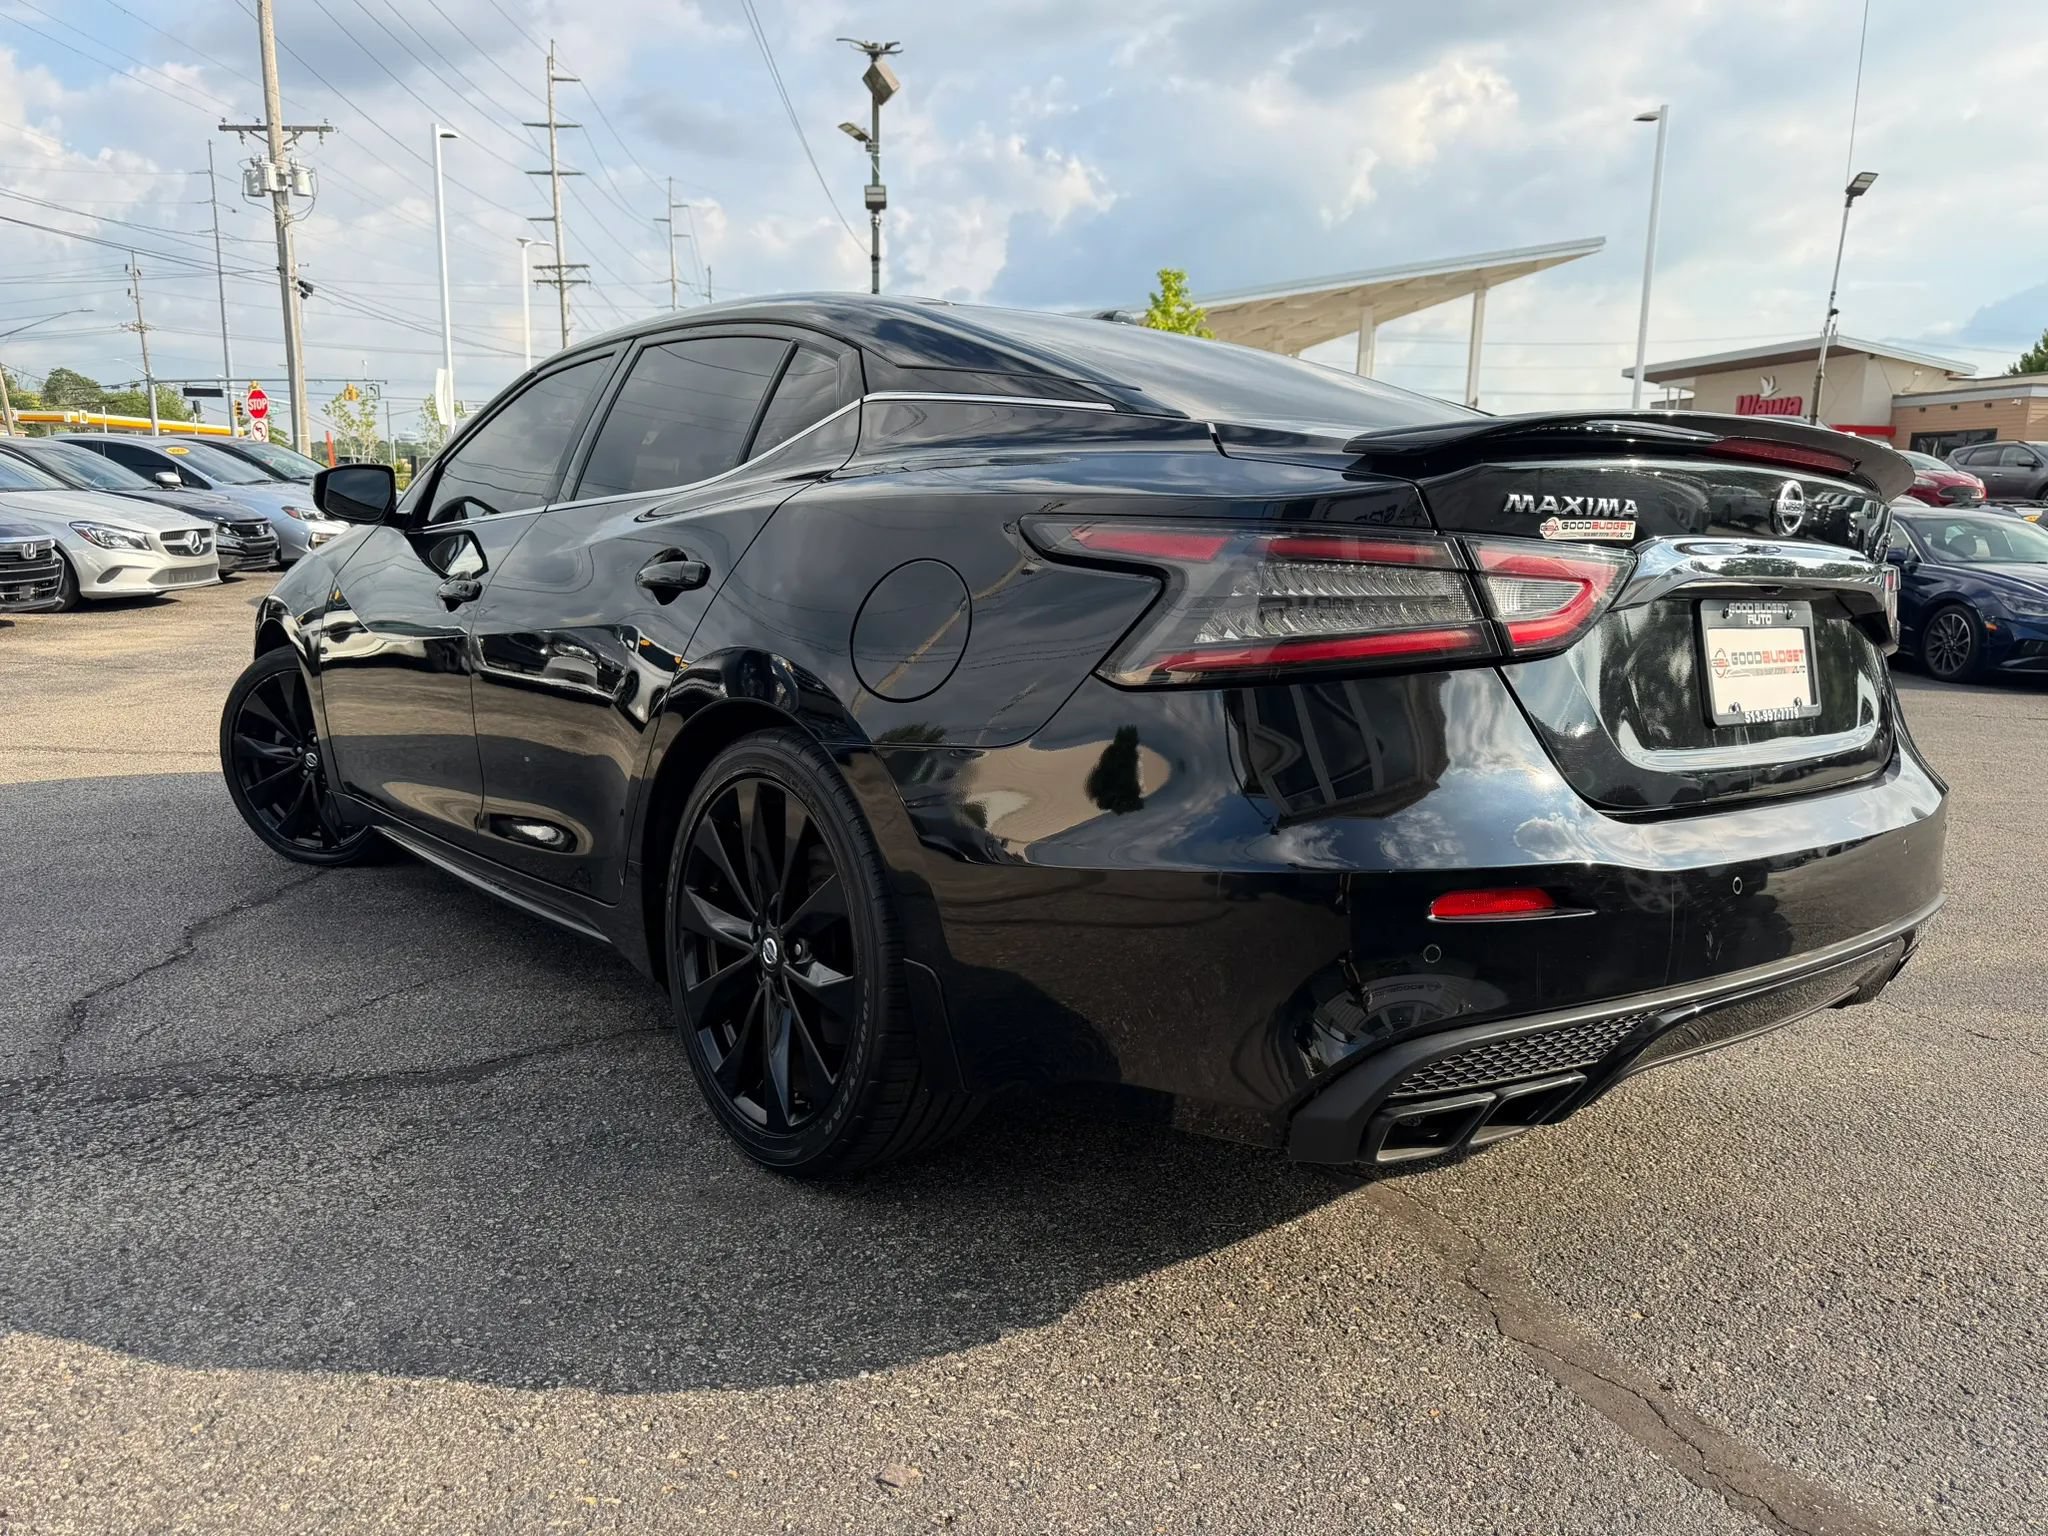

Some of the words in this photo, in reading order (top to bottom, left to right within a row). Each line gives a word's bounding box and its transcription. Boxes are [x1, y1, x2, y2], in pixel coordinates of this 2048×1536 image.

[249, 398, 266, 411] STOP
[1503, 493, 1639, 518] MAXIMA
[1562, 521, 1633, 531] GOODBUDGET
[1729, 603, 1753, 614] GOOD
[1754, 603, 1789, 614] BUDGET
[1747, 614, 1772, 625] AUTO
[1731, 649, 1804, 666] GOODBUDGET
